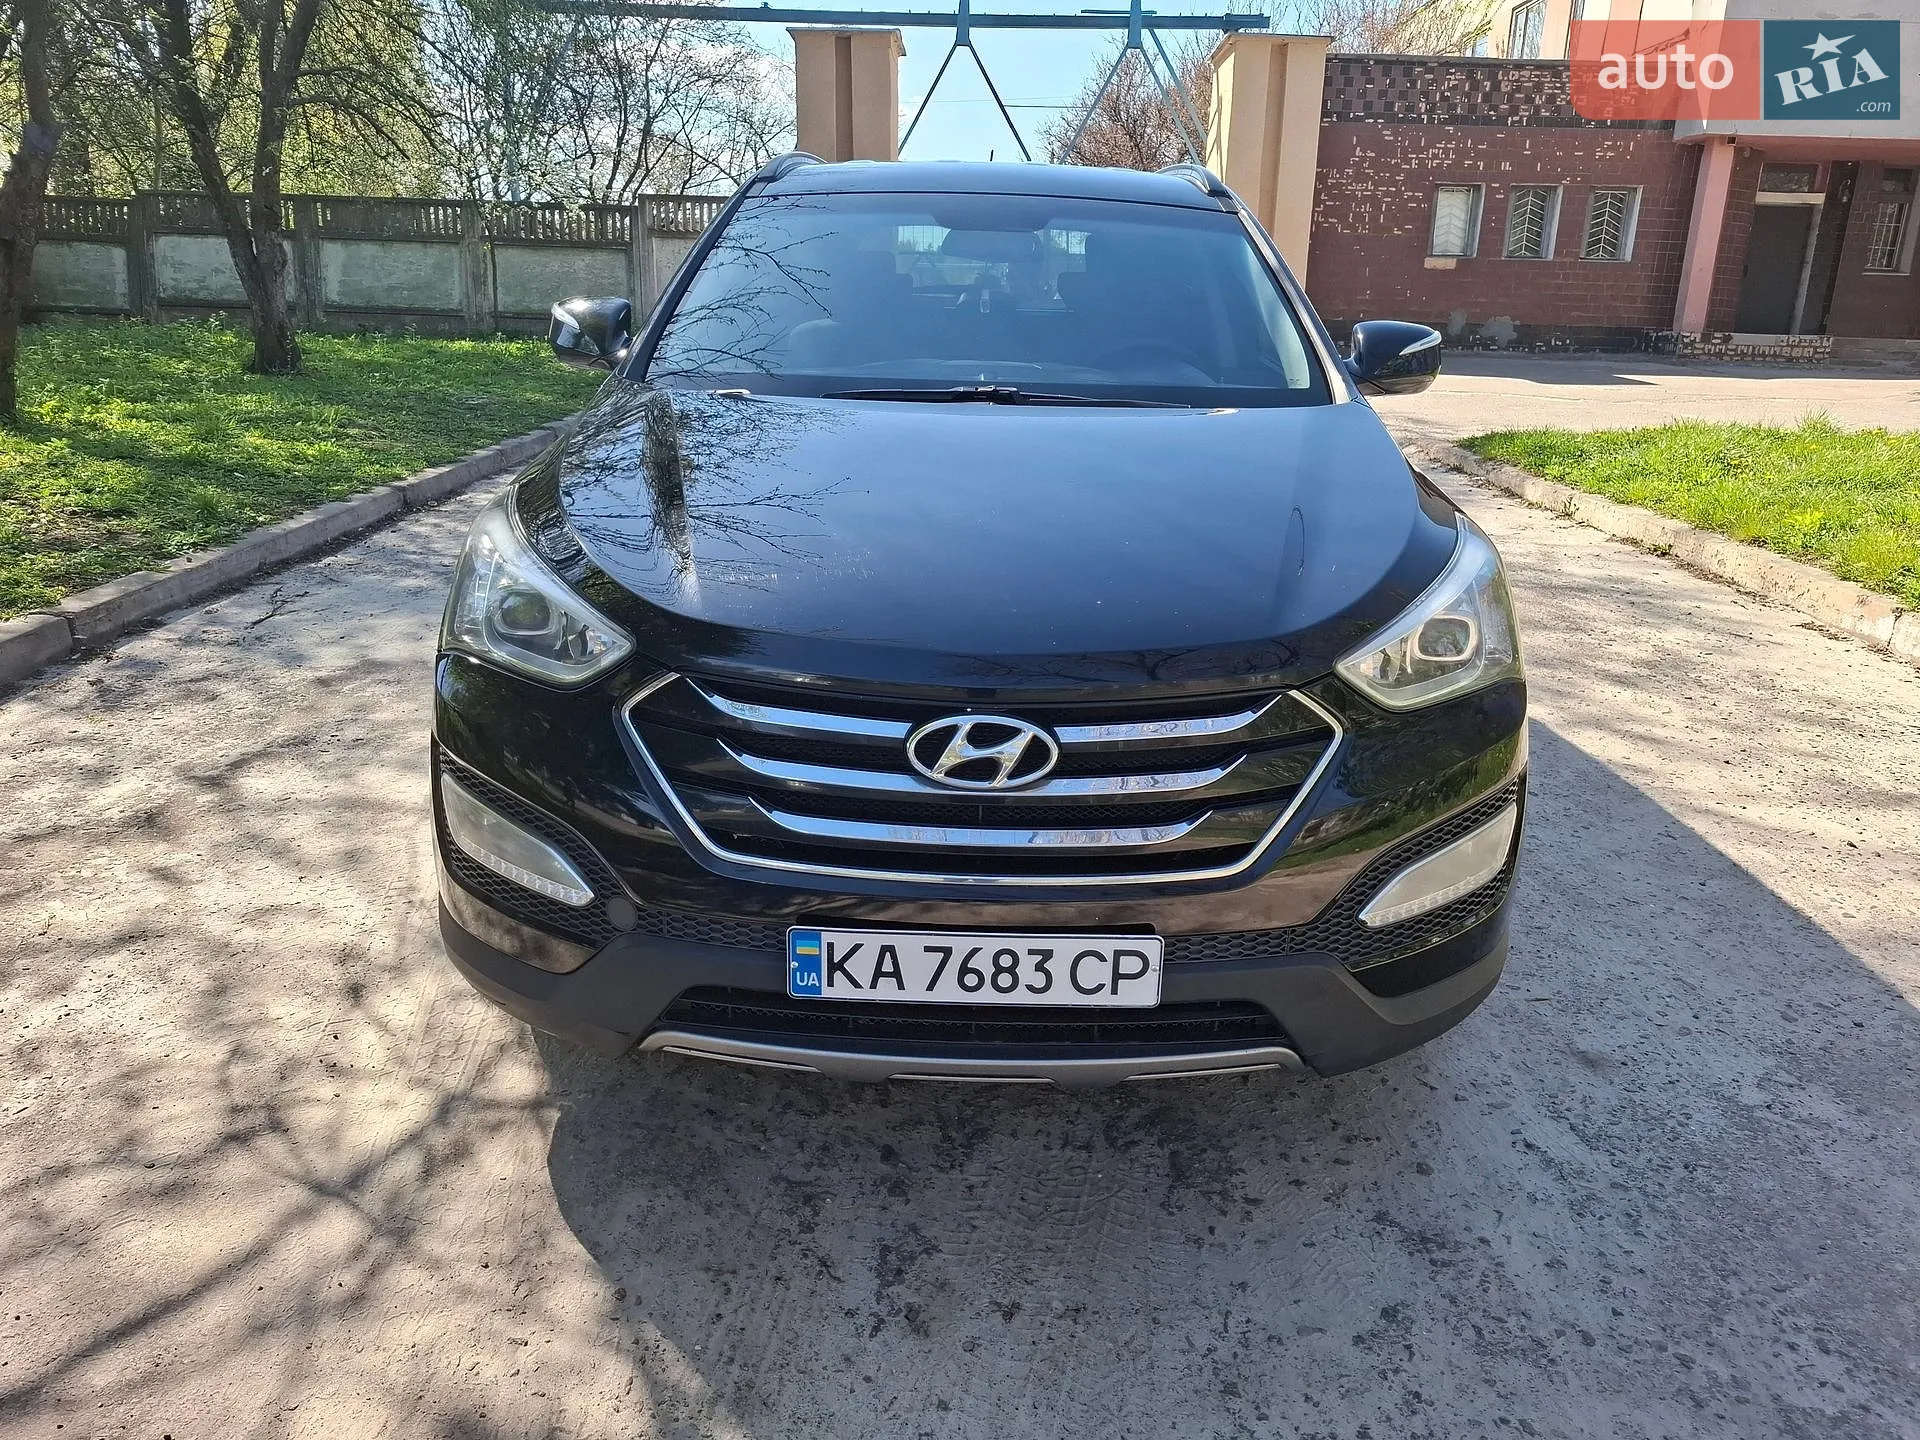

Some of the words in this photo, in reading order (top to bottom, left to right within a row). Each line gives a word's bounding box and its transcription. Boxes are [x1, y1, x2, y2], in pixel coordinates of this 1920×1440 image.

[796, 971, 820, 987] UA
[826, 941, 906, 990] KA
[923, 946, 1055, 994] 7683
[1069, 948, 1151, 996] CP
